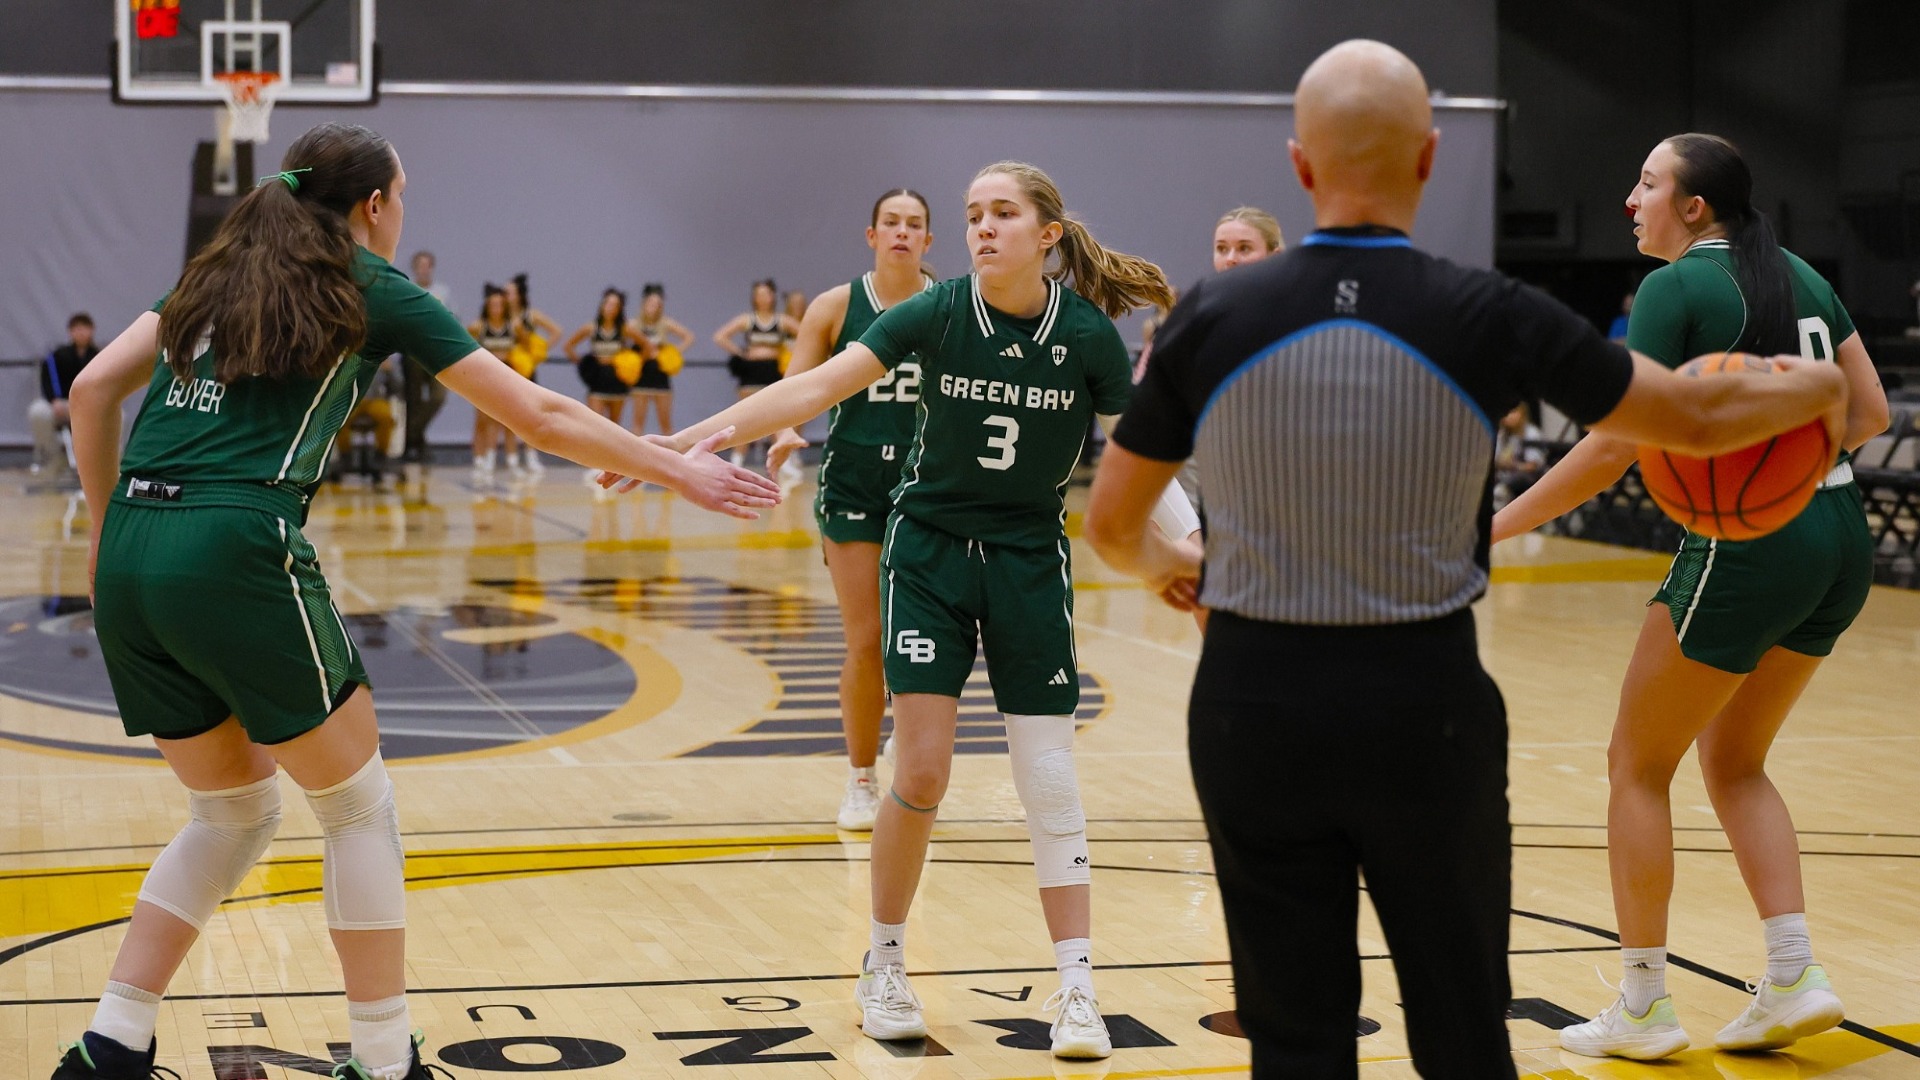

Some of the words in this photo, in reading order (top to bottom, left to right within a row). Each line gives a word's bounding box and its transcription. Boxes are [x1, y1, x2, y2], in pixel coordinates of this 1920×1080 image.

[166, 376, 226, 414] GUYER
[868, 363, 921, 402] 22
[941, 374, 1020, 405] GREEN
[1026, 387, 1075, 410] BAY
[977, 415, 1020, 471] 3
[897, 630, 936, 663] GB
